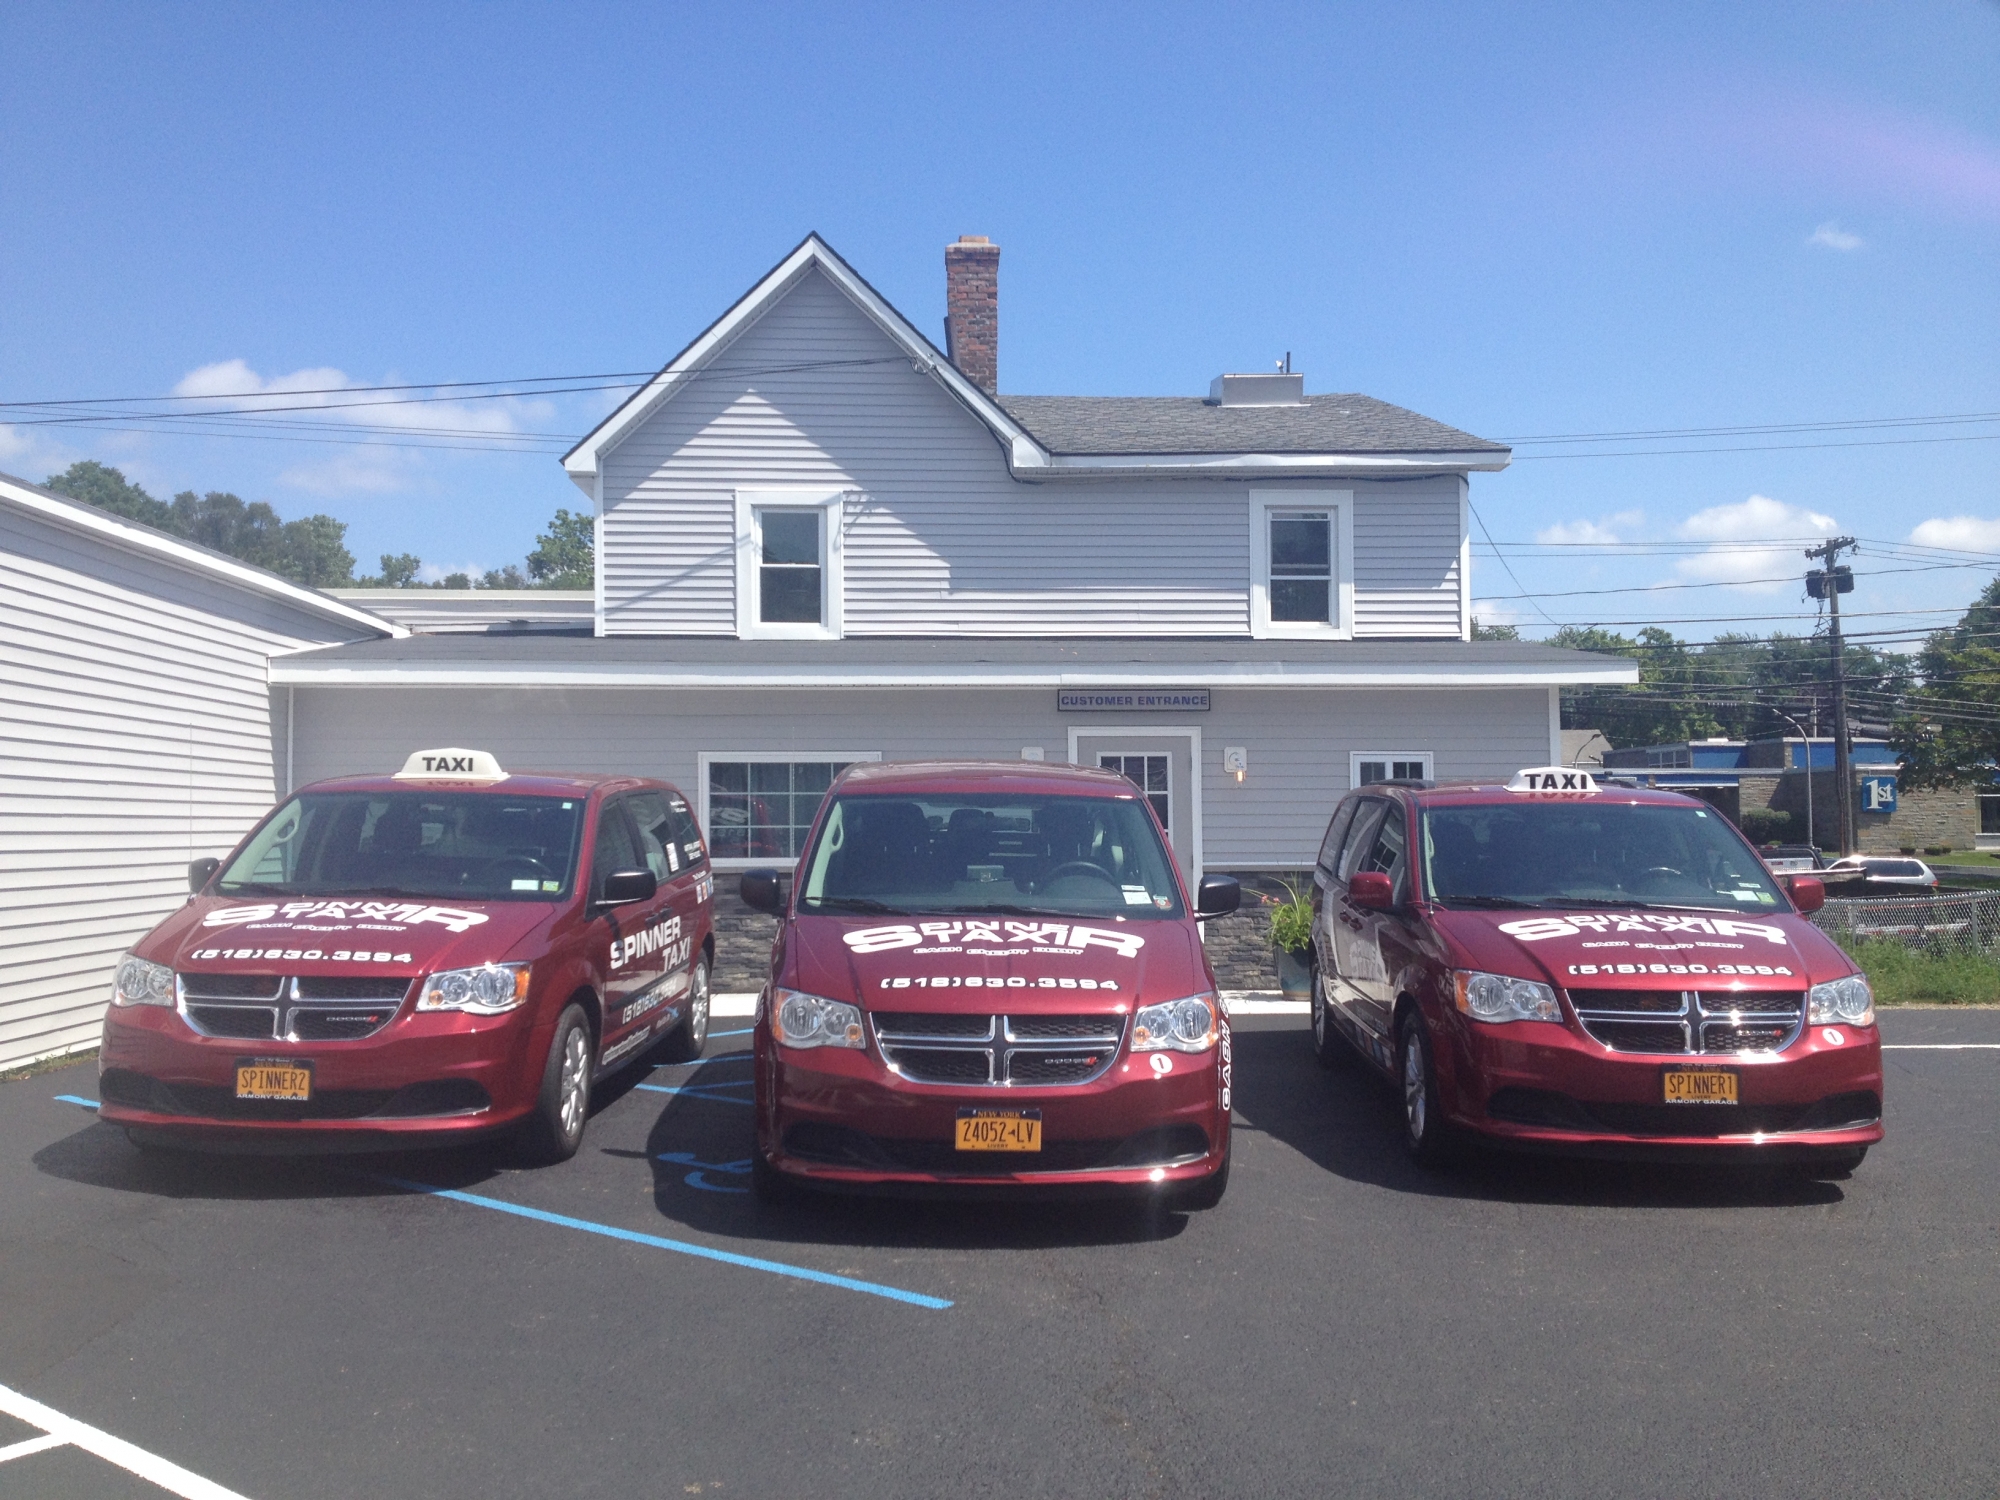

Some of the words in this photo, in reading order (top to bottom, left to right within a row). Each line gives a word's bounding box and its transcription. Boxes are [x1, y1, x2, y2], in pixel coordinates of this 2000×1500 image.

[1061, 695, 1133, 706] CUSTOMER
[1137, 695, 1208, 706] ENTRANCE
[421, 756, 475, 772] TAXI
[1524, 773, 1588, 790] TAXI
[1866, 779, 1894, 809] 1st
[279, 907, 417, 924] TAXI
[921, 928, 1070, 945] TAXI
[1498, 914, 1788, 945] SPINNER
[1581, 921, 1716, 935] TAXI
[610, 915, 681, 970] SPINNER
[843, 920, 1146, 959] SPINNER
[190, 949, 413, 964] (518)630.3594
[662, 935, 691, 972] TAXI
[1567, 963, 1794, 977] (518)630.3594
[880, 976, 1121, 991] (518)630.3594
[1221, 1019, 1231, 1111] CASH
[241, 1069, 306, 1091] SPINNER2
[1669, 1074, 1733, 1095] SPINNER1
[999, 1110, 1021, 1118] YORK
[963, 1121, 1007, 1142] 24052
